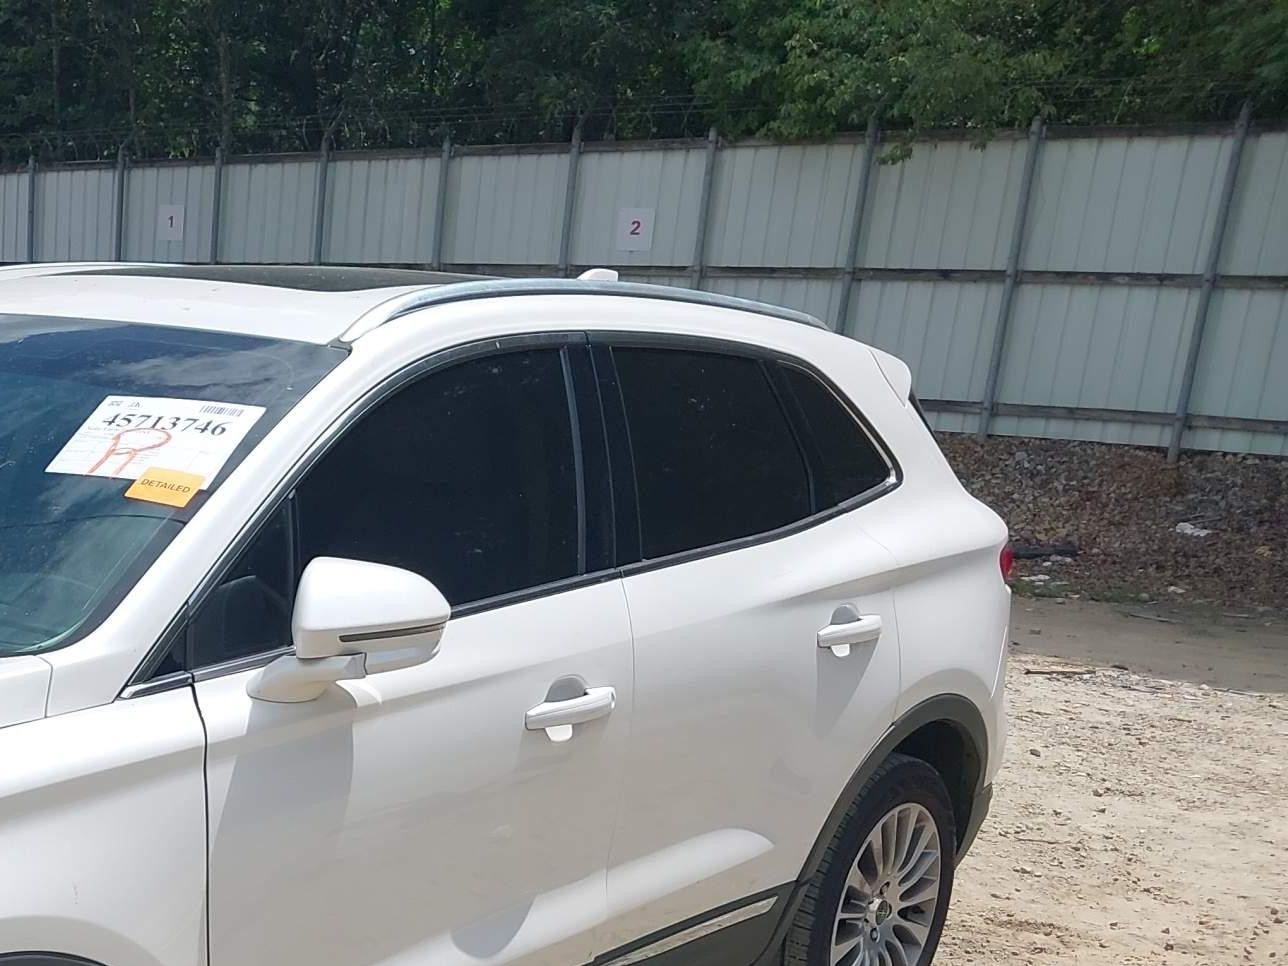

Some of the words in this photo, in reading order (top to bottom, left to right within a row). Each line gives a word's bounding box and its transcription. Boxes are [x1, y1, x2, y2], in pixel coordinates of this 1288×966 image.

[167, 215, 174, 229] 1
[629, 220, 641, 236] 2
[102, 413, 232, 436] 45713746
[140, 478, 191, 493] DETAILED
